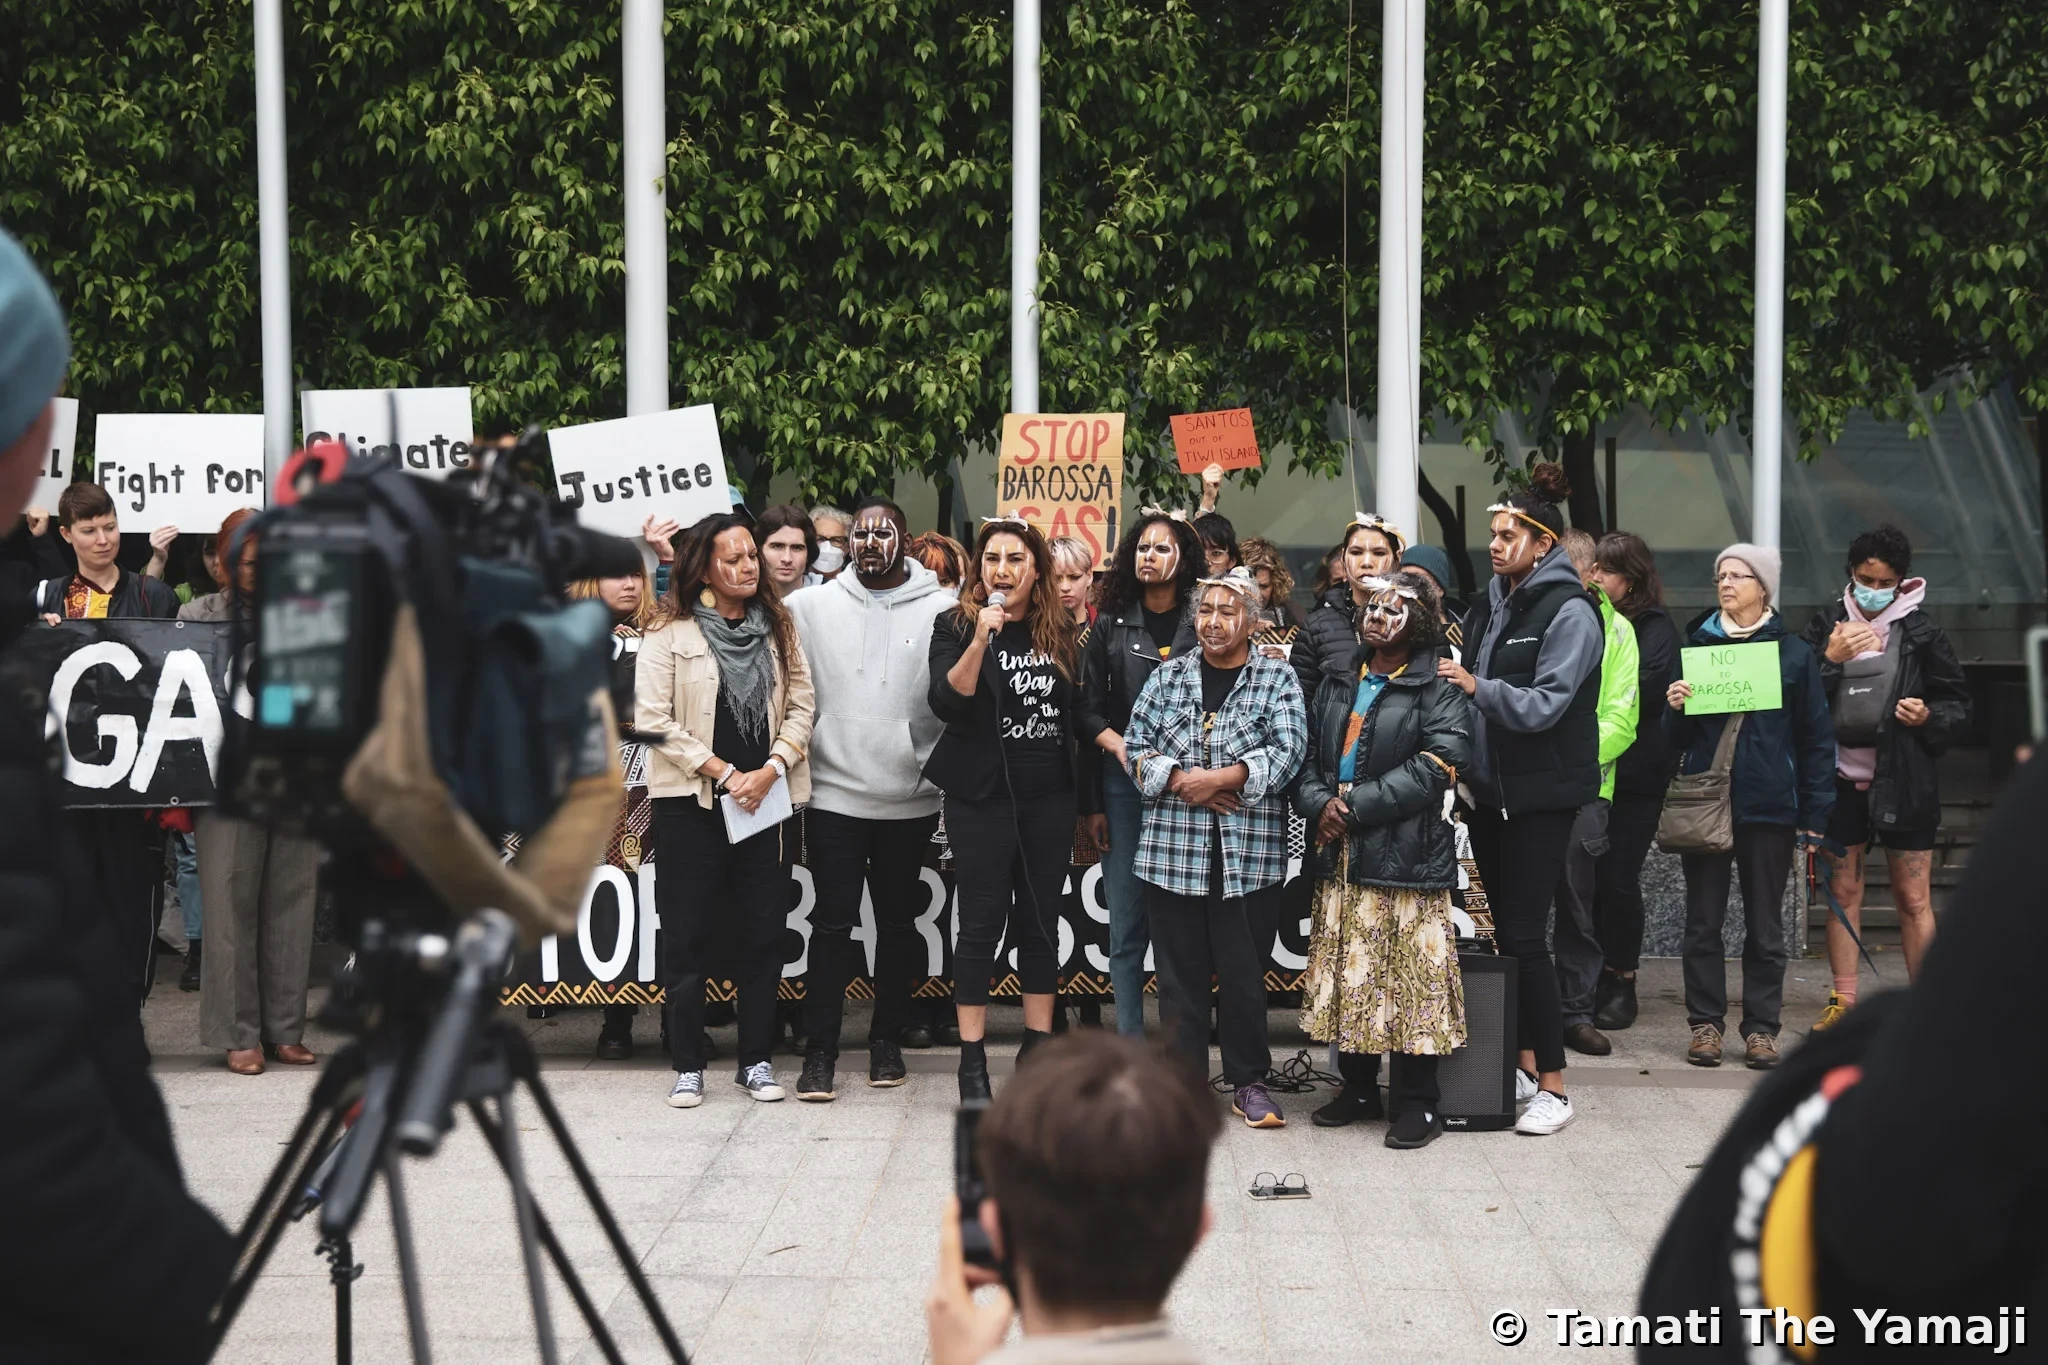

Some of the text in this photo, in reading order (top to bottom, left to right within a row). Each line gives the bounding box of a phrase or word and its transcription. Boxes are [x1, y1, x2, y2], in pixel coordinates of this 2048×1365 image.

[1185, 411, 1250, 432] SANTOS
[1014, 420, 1110, 466] STOP
[1189, 435, 1225, 446] OUT OF
[1184, 449, 1215, 463] TIWI
[99, 461, 185, 512] Fight
[206, 463, 263, 494] for
[560, 462, 713, 509] Justice
[1003, 463, 1113, 502] BAROSSA
[1711, 649, 1736, 666] NO
[1009, 670, 1056, 697] Day
[1689, 680, 1753, 696] BAROSSA
[1023, 694, 1037, 706] in
[1727, 697, 1757, 710] GAS
[1039, 702, 1060, 717] the
